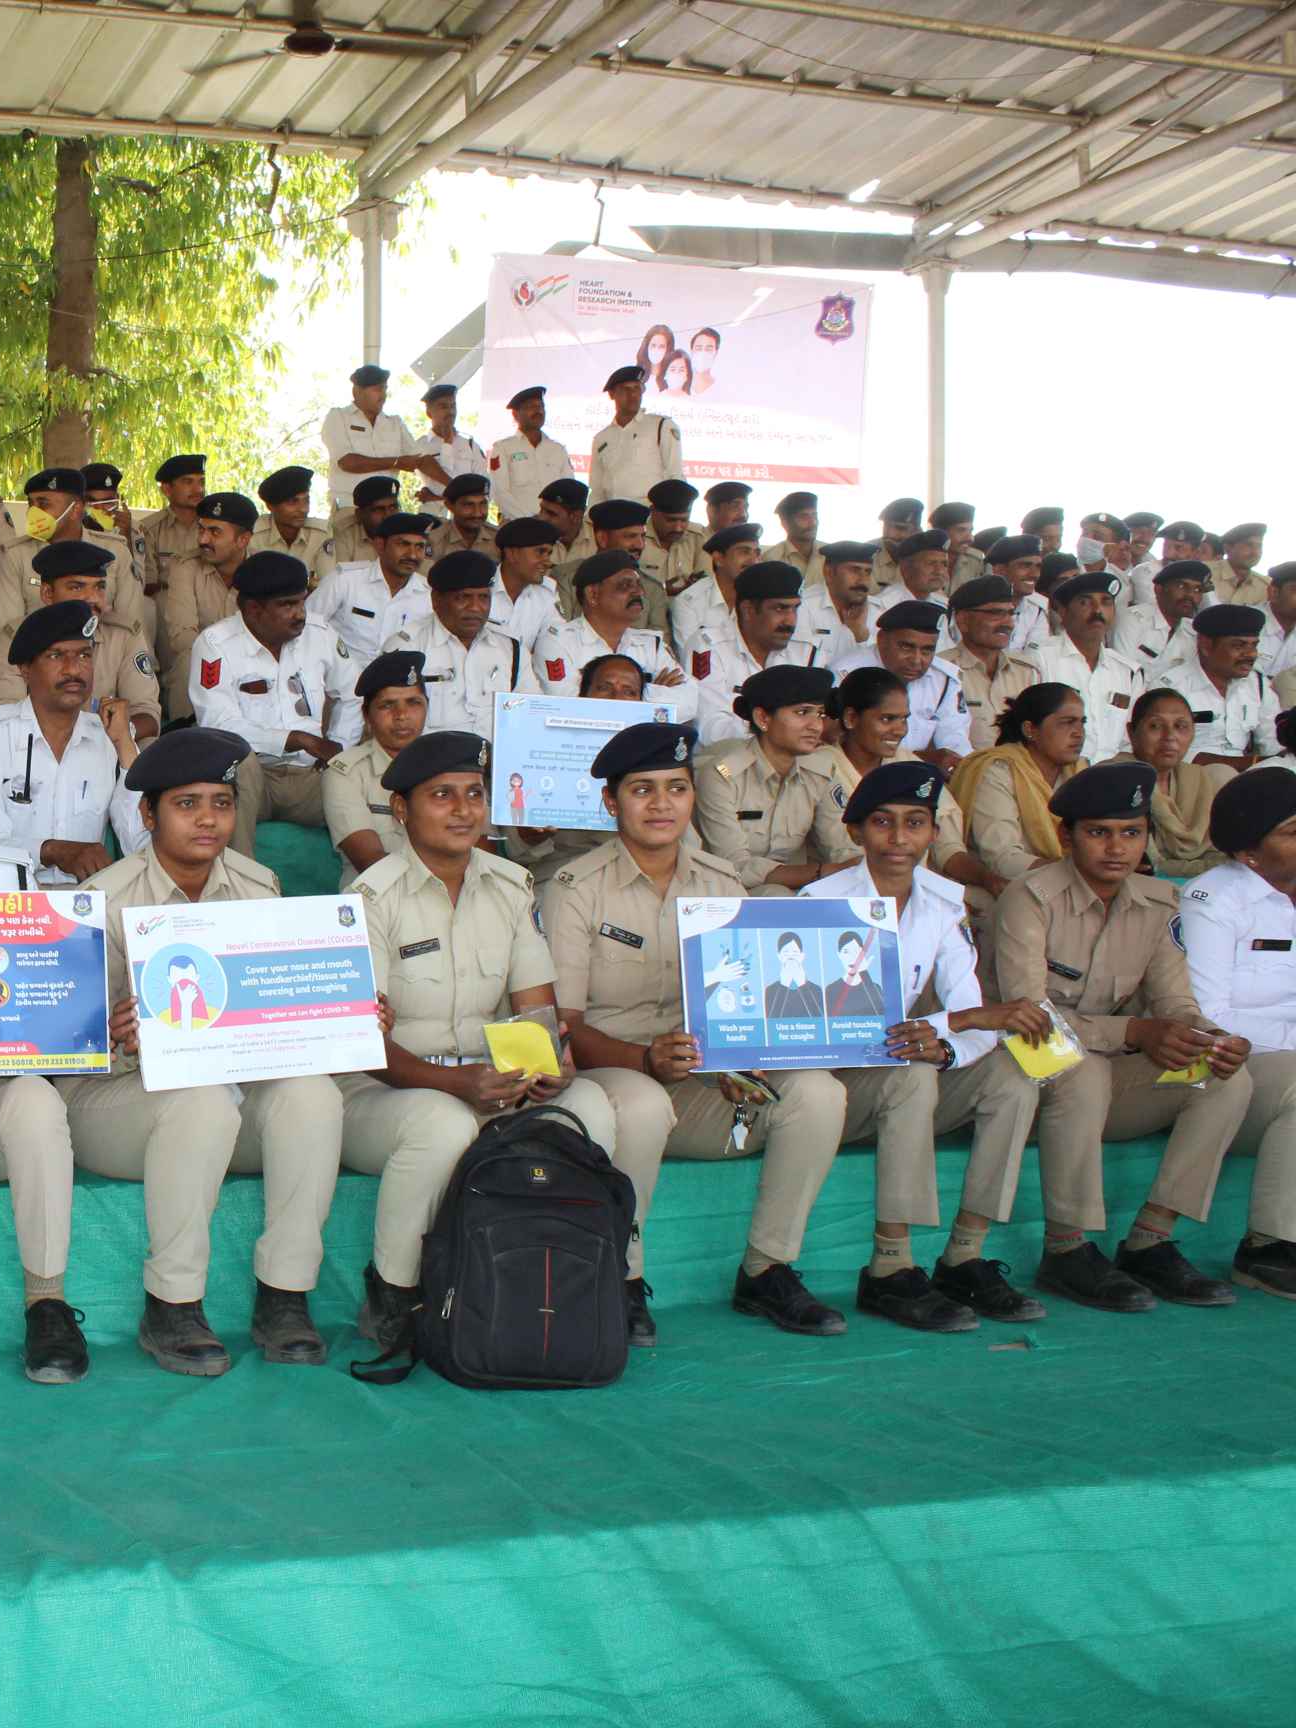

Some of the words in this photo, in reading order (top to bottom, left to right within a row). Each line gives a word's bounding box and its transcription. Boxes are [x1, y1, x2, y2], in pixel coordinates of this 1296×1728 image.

[579, 279, 604, 288] HEART
[578, 287, 626, 297] FOUNDATION
[577, 295, 616, 305] RESEARCH
[616, 298, 652, 308] INSTITUTE
[26, 896, 33, 912] !
[245, 965, 269, 975] Cover
[270, 964, 289, 976] your
[289, 962, 310, 972] nose
[311, 959, 326, 970] and
[326, 958, 353, 969] mouth
[240, 976, 259, 987] with
[338, 969, 361, 979] while
[258, 985, 295, 998] sneezing
[295, 983, 311, 994] and
[311, 981, 349, 994] coughing
[719, 1023, 738, 1033] Wash
[738, 1024, 755, 1034] your
[775, 1023, 790, 1032] Use
[795, 1022, 816, 1032] tissue
[831, 1021, 852, 1030] Avoid
[852, 1020, 882, 1031] touching
[726, 1033, 747, 1042] hands
[778, 1032, 790, 1041] for
[790, 1033, 816, 1043] coughs
[840, 1031, 857, 1041] your
[856, 1029, 873, 1039] face
